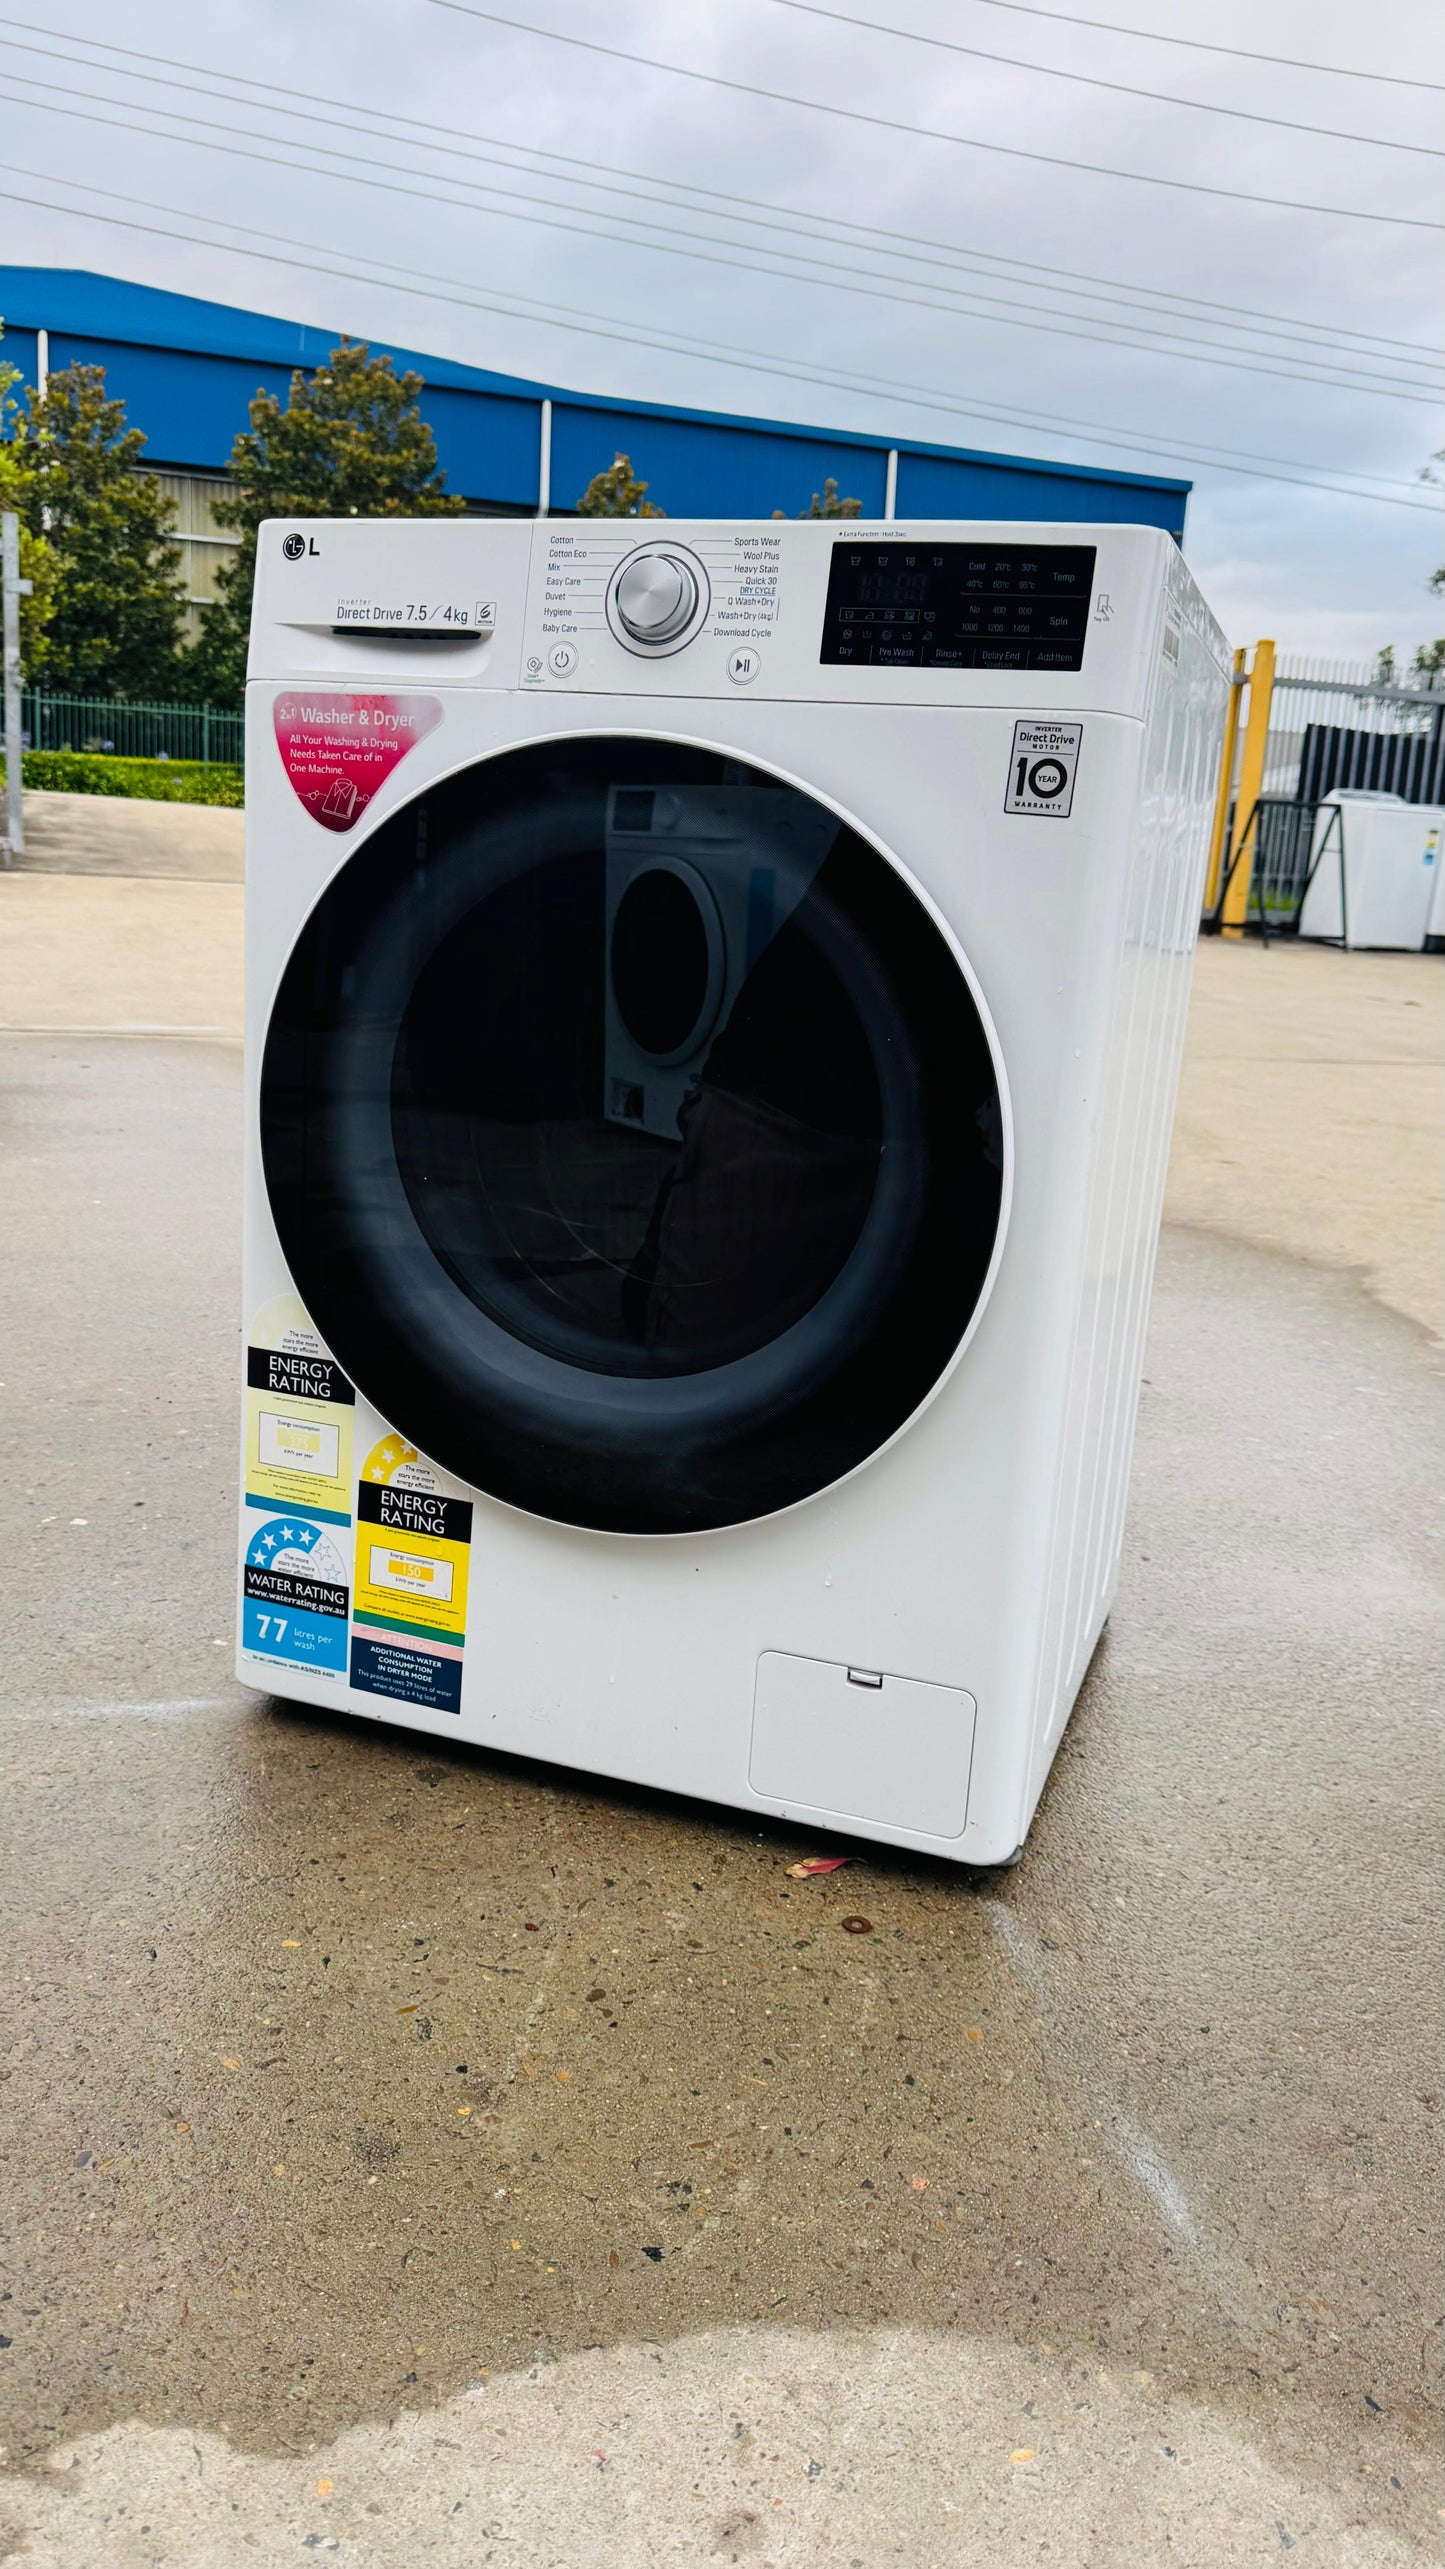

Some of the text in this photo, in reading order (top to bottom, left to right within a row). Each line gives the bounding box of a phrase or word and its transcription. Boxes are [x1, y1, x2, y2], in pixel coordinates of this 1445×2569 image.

[550, 536, 574, 545] Cotton
[734, 537, 781, 546] Sports Wear
[309, 537, 320, 556] L
[549, 550, 587, 558] Cotton Eco
[743, 551, 780, 560] Wool Plus
[548, 563, 560, 571] Mix
[734, 565, 779, 574] Heavy Stain
[969, 562, 986, 571] Cold
[546, 577, 581, 586] Easy Care
[745, 577, 778, 585] Quick 30
[1053, 572, 1076, 583] Temp
[545, 592, 566, 601] Duvet
[740, 587, 776, 595] DRY CYCLE
[735, 597, 775, 607] Wash+Dry
[337, 606, 370, 620] Direct
[373, 607, 403, 621] Drive
[406, 604, 427, 621] 7.5
[544, 607, 572, 617] Hygiene
[970, 605, 981, 614] No
[992, 606, 1007, 615] 400
[717, 611, 757, 621] Wash+Dry
[1049, 616, 1069, 627] Spin
[543, 624, 578, 633] Baby Care
[713, 627, 772, 638] Download Cycle
[962, 623, 1030, 633] 1000 1200 1400
[839, 646, 853, 656] Dry
[893, 648, 914, 657] Wash
[982, 650, 1020, 661] Delay End
[1037, 652, 1073, 663] Add Item
[301, 707, 355, 724] Washer
[359, 710, 370, 725] &
[374, 711, 415, 731] Dryer
[290, 734, 398, 751] All Your Washing & Drying
[1019, 732, 1075, 745] Direct Drive
[290, 749, 383, 762] Needs Taken Care of in
[290, 763, 345, 775] One Machine.
[1016, 757, 1068, 799] 10
[1038, 775, 1058, 783] YEAR
[1014, 801, 1062, 810] WARRANTY
[282, 1344, 319, 1355] energy efficient
[269, 1355, 333, 1380] ENERGY
[269, 1373, 331, 1398] RATING
[277, 1419, 320, 1432] Energy consumption
[412, 1473, 420, 1481] the
[397, 1479, 435, 1491] energy efficient
[381, 1490, 448, 1517] ENERGY
[381, 1508, 445, 1534] RATING
[284, 1553, 294, 1561] The
[390, 1552, 405, 1561] Energy
[291, 1561, 300, 1569] the
[293, 1570, 314, 1578] efficient
[402, 1564, 422, 1578] 150
[248, 1571, 292, 1593] WATER
[296, 1583, 345, 1604] RATING
[247, 1587, 345, 1615] www.waterrating.gov.au
[256, 1613, 288, 1643] 77
[294, 1627, 333, 1644] litres per
[294, 1641, 315, 1651] wash
[381, 1633, 433, 1652] ATTENTION
[370, 1646, 442, 1668] ADDITIONAL WATER
[378, 1656, 433, 1675] CONSUMPTION
[378, 1664, 433, 1683] IN DRYER MODE
[357, 1669, 369, 1678] This
[370, 1673, 391, 1683] product
[392, 1678, 405, 1687] uses
[406, 1680, 413, 1688] 29
[414, 1682, 428, 1692] litres
[436, 1689, 453, 1697] water
[373, 1682, 388, 1691] when
[388, 1685, 406, 1696] drying
[416, 1692, 423, 1700] kg
[424, 1693, 437, 1702] load
